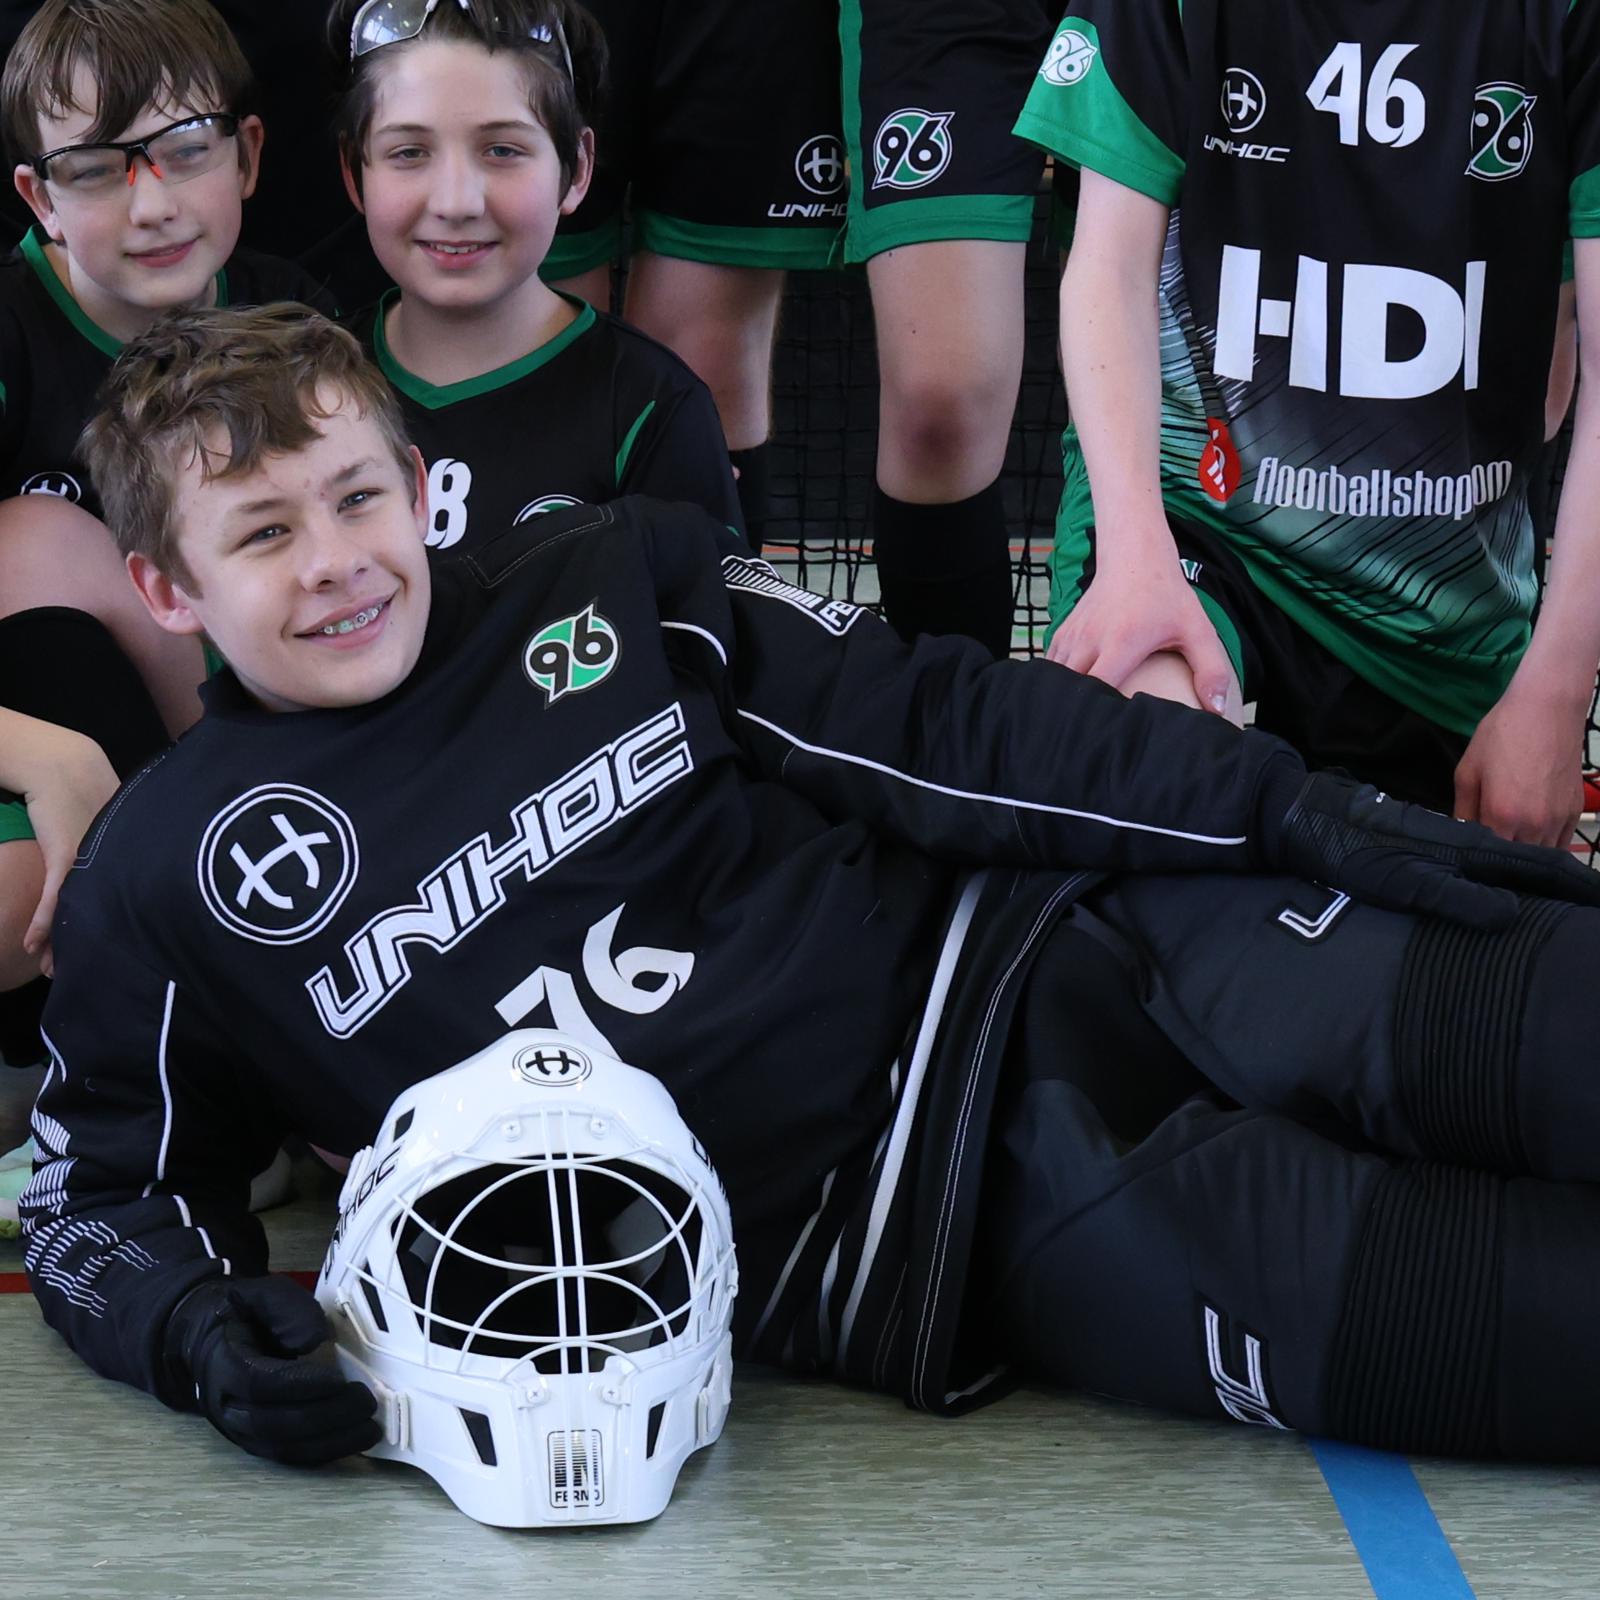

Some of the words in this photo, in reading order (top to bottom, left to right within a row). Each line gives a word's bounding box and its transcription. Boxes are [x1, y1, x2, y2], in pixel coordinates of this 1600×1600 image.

[1040, 33, 1095, 82] 96
[1305, 42, 1426, 148] 46
[876, 114, 950, 185] 96
[1213, 245, 1487, 399] HDI
[528, 604, 617, 703] 96
[305, 701, 695, 1040] UNIHOC
